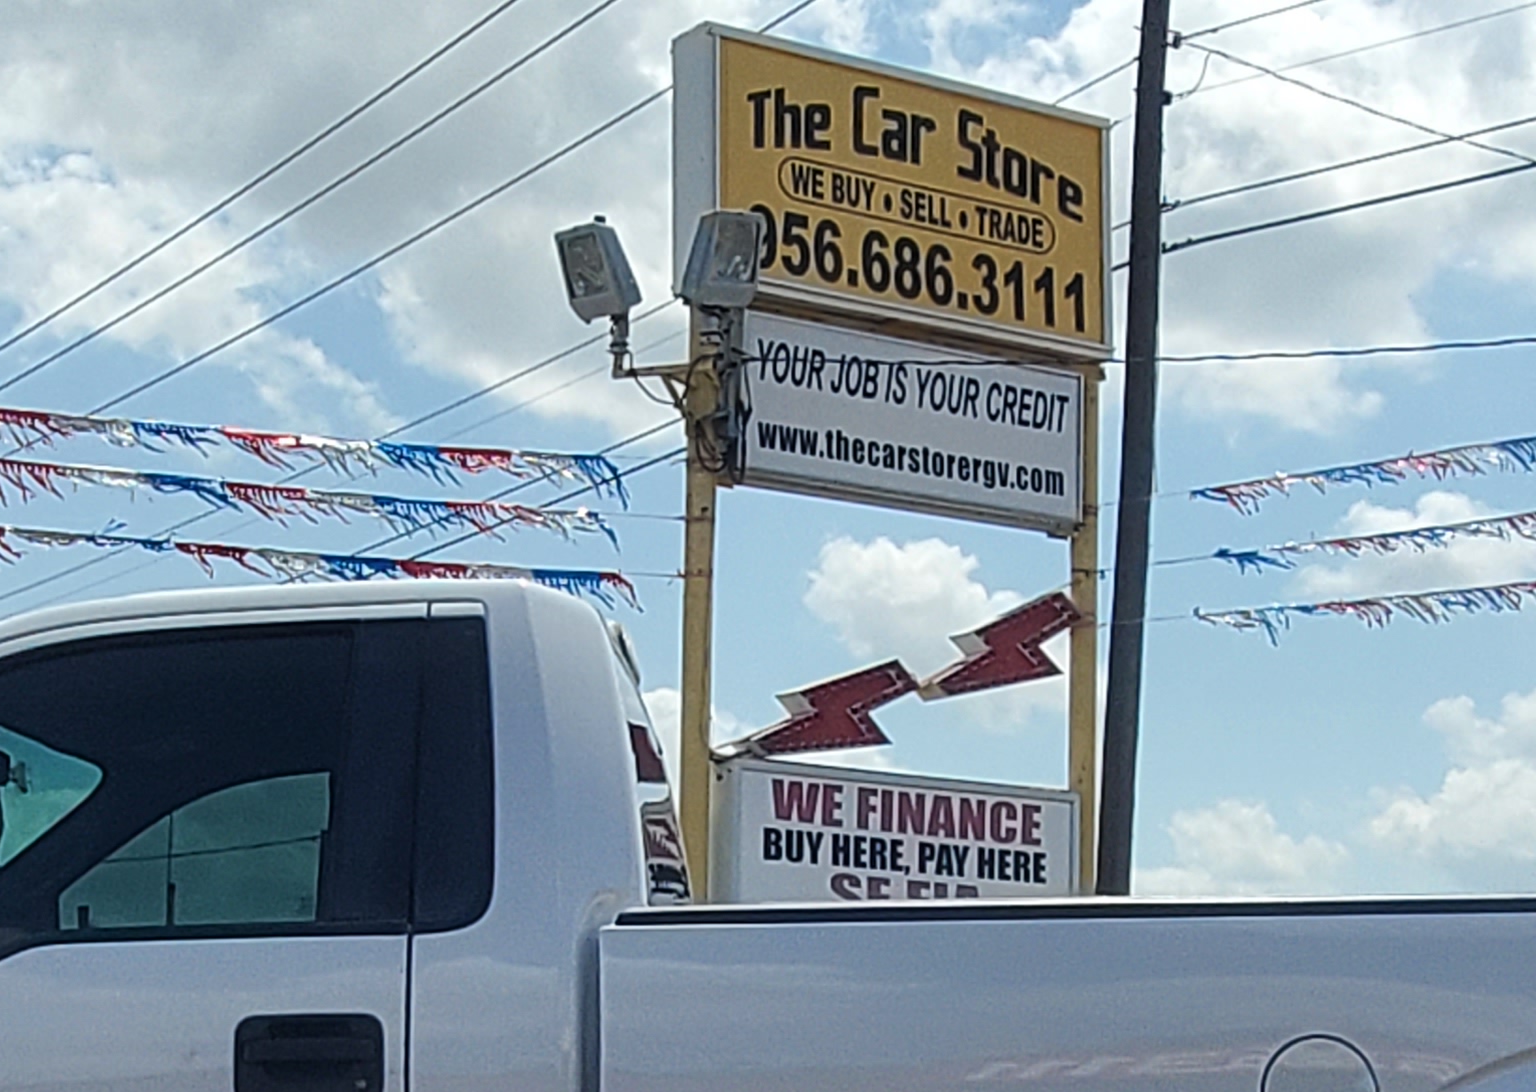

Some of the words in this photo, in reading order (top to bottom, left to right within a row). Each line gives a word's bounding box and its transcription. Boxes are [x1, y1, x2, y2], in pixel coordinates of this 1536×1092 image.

[747, 86, 832, 151] The
[852, 84, 937, 167] Car
[956, 107, 1084, 224] Store
[790, 161, 825, 201] WE
[831, 171, 876, 213] BUY
[900, 188, 953, 229] SELL
[974, 205, 1045, 249] TRADE
[757, 337, 823, 392] YOUR
[830, 353, 879, 399] JOB
[884, 362, 908, 405] IS
[916, 367, 981, 419] YOUR
[985, 381, 1070, 434] CREDIT
[757, 421, 1065, 497] www.thecarstorergv.com
[771, 778, 844, 828] WE
[856, 786, 1043, 847] FINANCE
[763, 827, 824, 865] BUY
[831, 833, 911, 876] HERE,
[918, 841, 970, 878] PAY
[976, 846, 1047, 885] HERE
